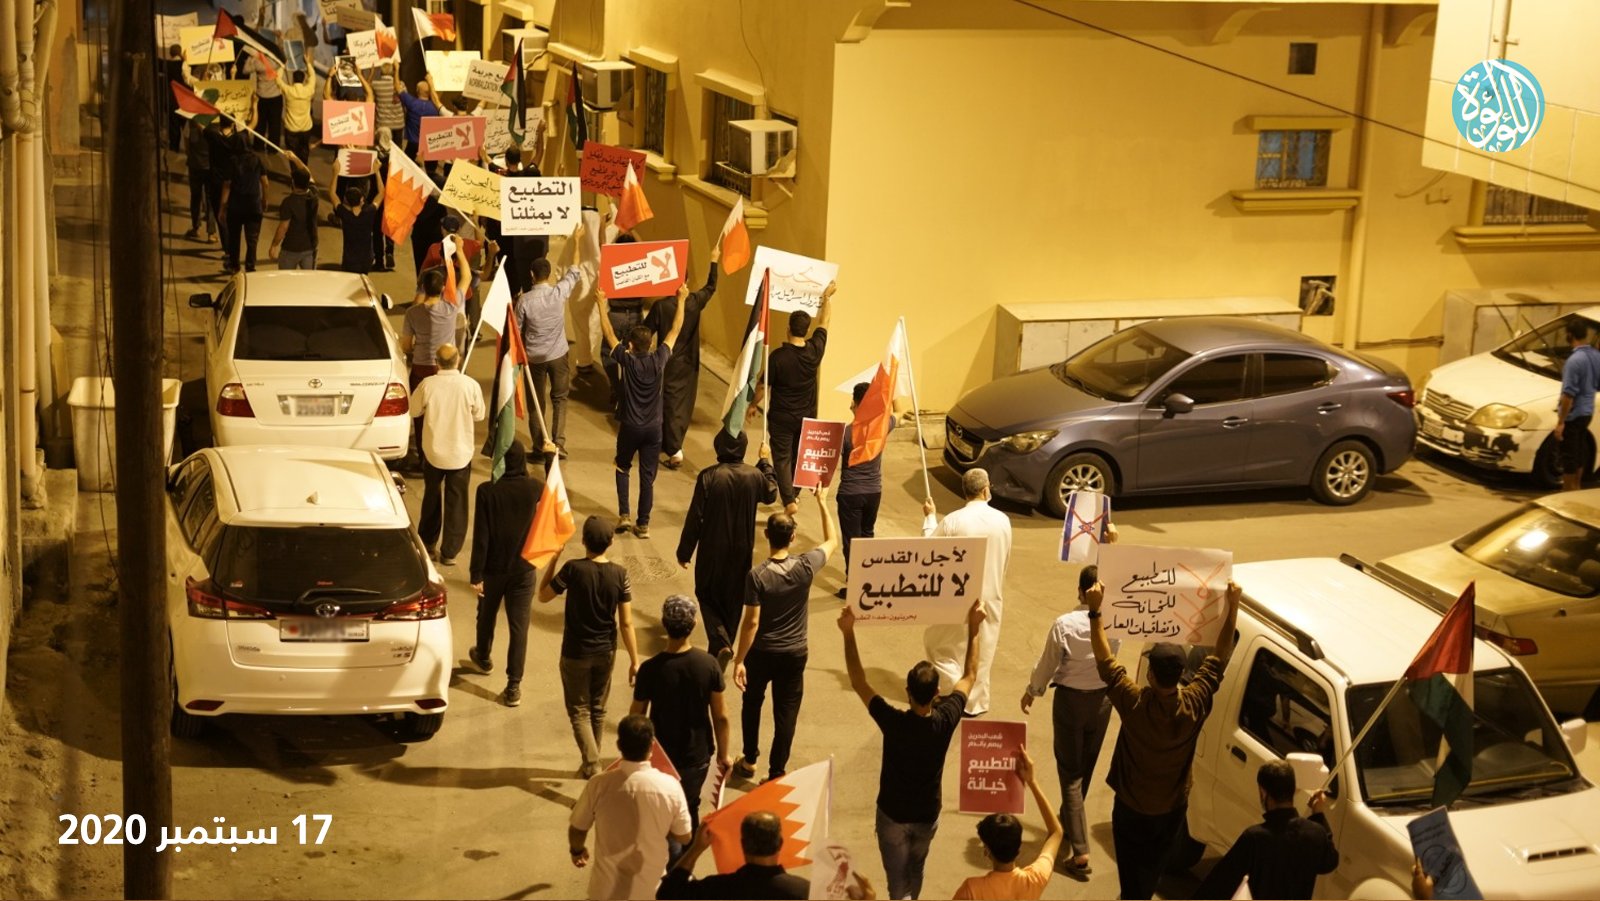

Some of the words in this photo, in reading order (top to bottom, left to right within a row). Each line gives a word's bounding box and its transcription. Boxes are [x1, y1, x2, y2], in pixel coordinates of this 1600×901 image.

[428, 131, 453, 145] للتطبيع
[508, 181, 573, 204] التطبيع
[511, 206, 553, 225] يمثلنا
[556, 206, 570, 220] لا
[614, 261, 648, 280] للتطبيع
[651, 251, 672, 281] لا
[801, 461, 829, 476] خيانة
[862, 550, 918, 568] القدس
[921, 546, 967, 567] لأجل
[951, 572, 970, 597] لا
[1121, 561, 1176, 595] للتطبيع
[859, 572, 945, 611] للتطبيع
[1112, 594, 1176, 619] للخيانة
[1103, 614, 1134, 631] العار
[967, 757, 1016, 774] التطبيع
[967, 777, 1007, 795] خيانة
